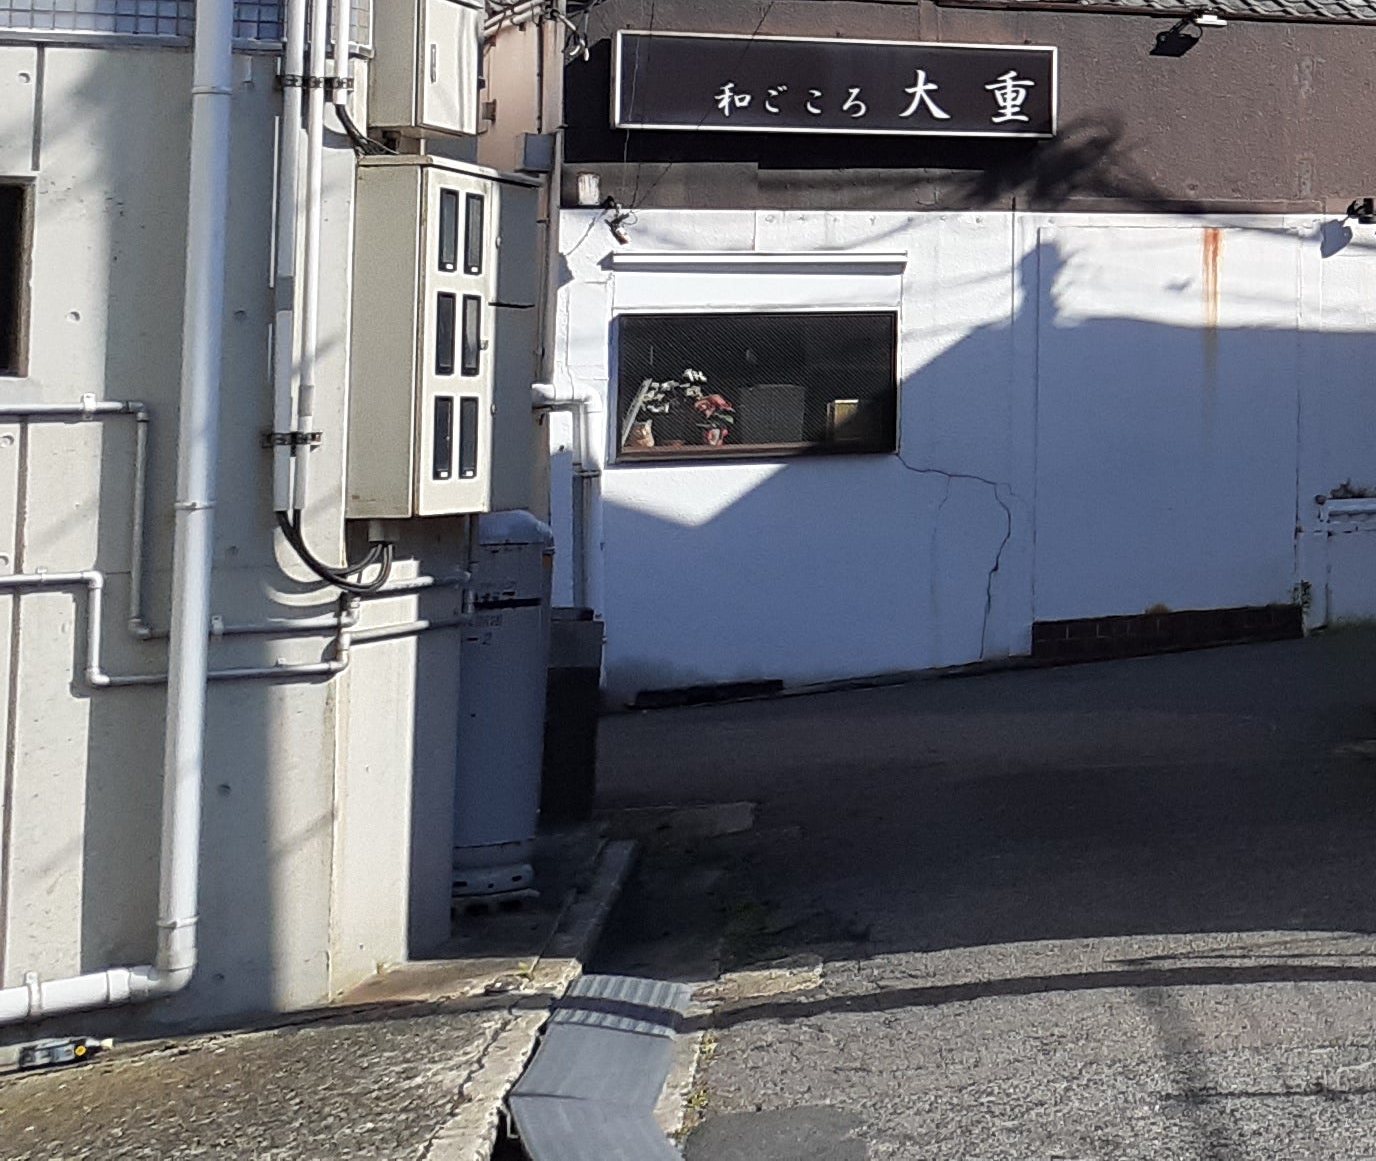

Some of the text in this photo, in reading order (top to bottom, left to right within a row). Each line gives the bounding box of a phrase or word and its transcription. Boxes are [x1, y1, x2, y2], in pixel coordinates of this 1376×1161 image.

[714, 69, 1036, 124] 和ごころ 大重
